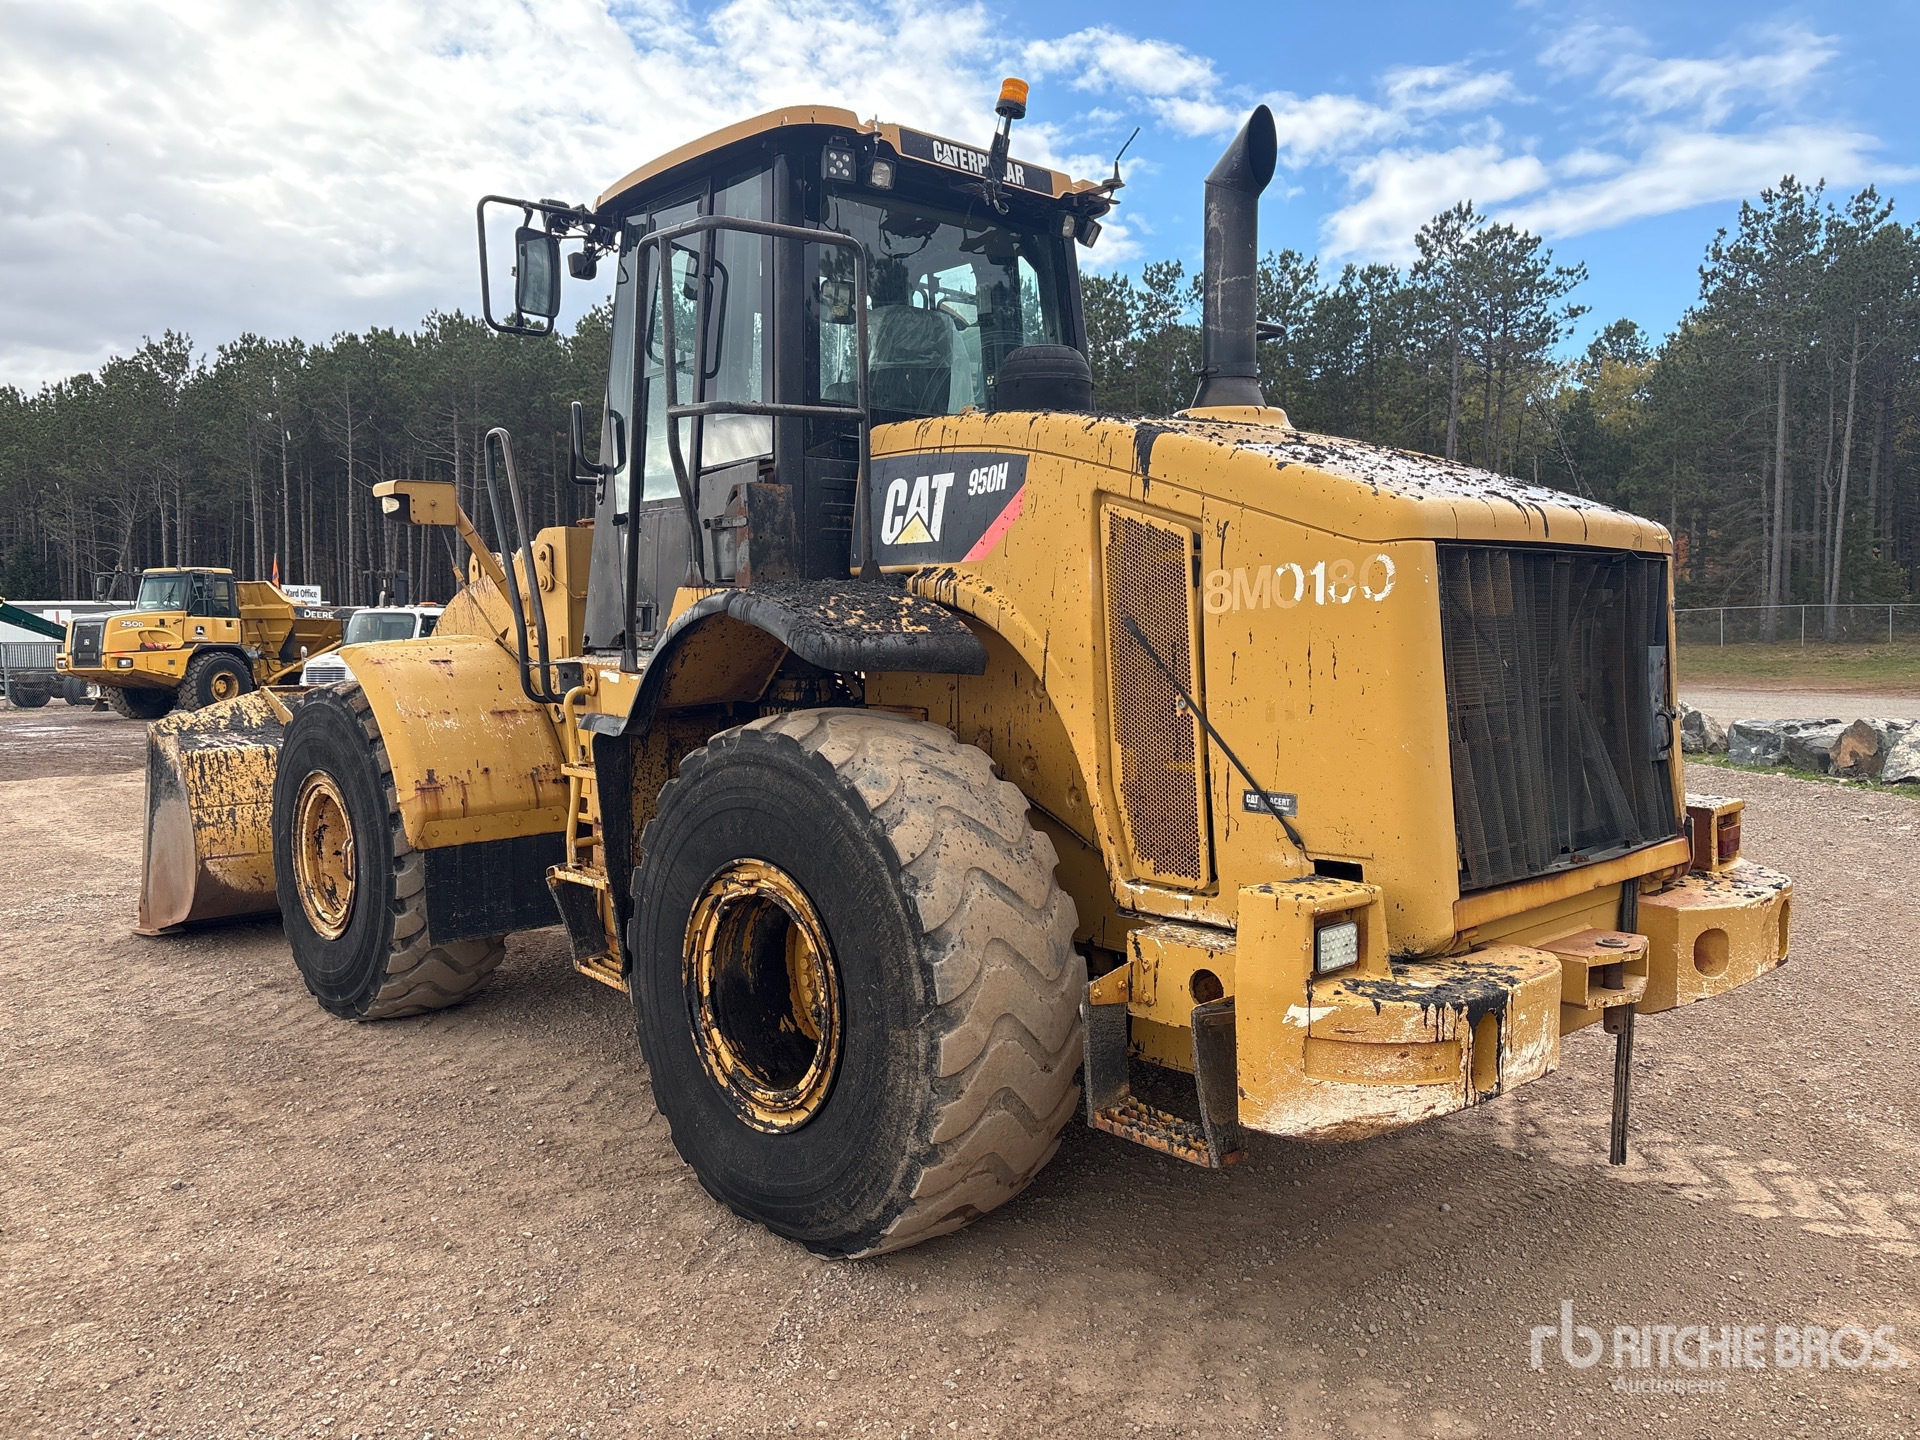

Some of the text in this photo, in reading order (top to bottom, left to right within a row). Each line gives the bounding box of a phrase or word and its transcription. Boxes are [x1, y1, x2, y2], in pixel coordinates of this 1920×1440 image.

[932, 140, 1025, 186] CATERPAR
[968, 462, 1009, 496] 950H
[881, 472, 955, 545] CAT
[285, 588, 318, 598] Yard Office
[304, 609, 334, 619] DEERE
[120, 620, 144, 628] 250D
[1246, 794, 1291, 806] CAT ACERT
